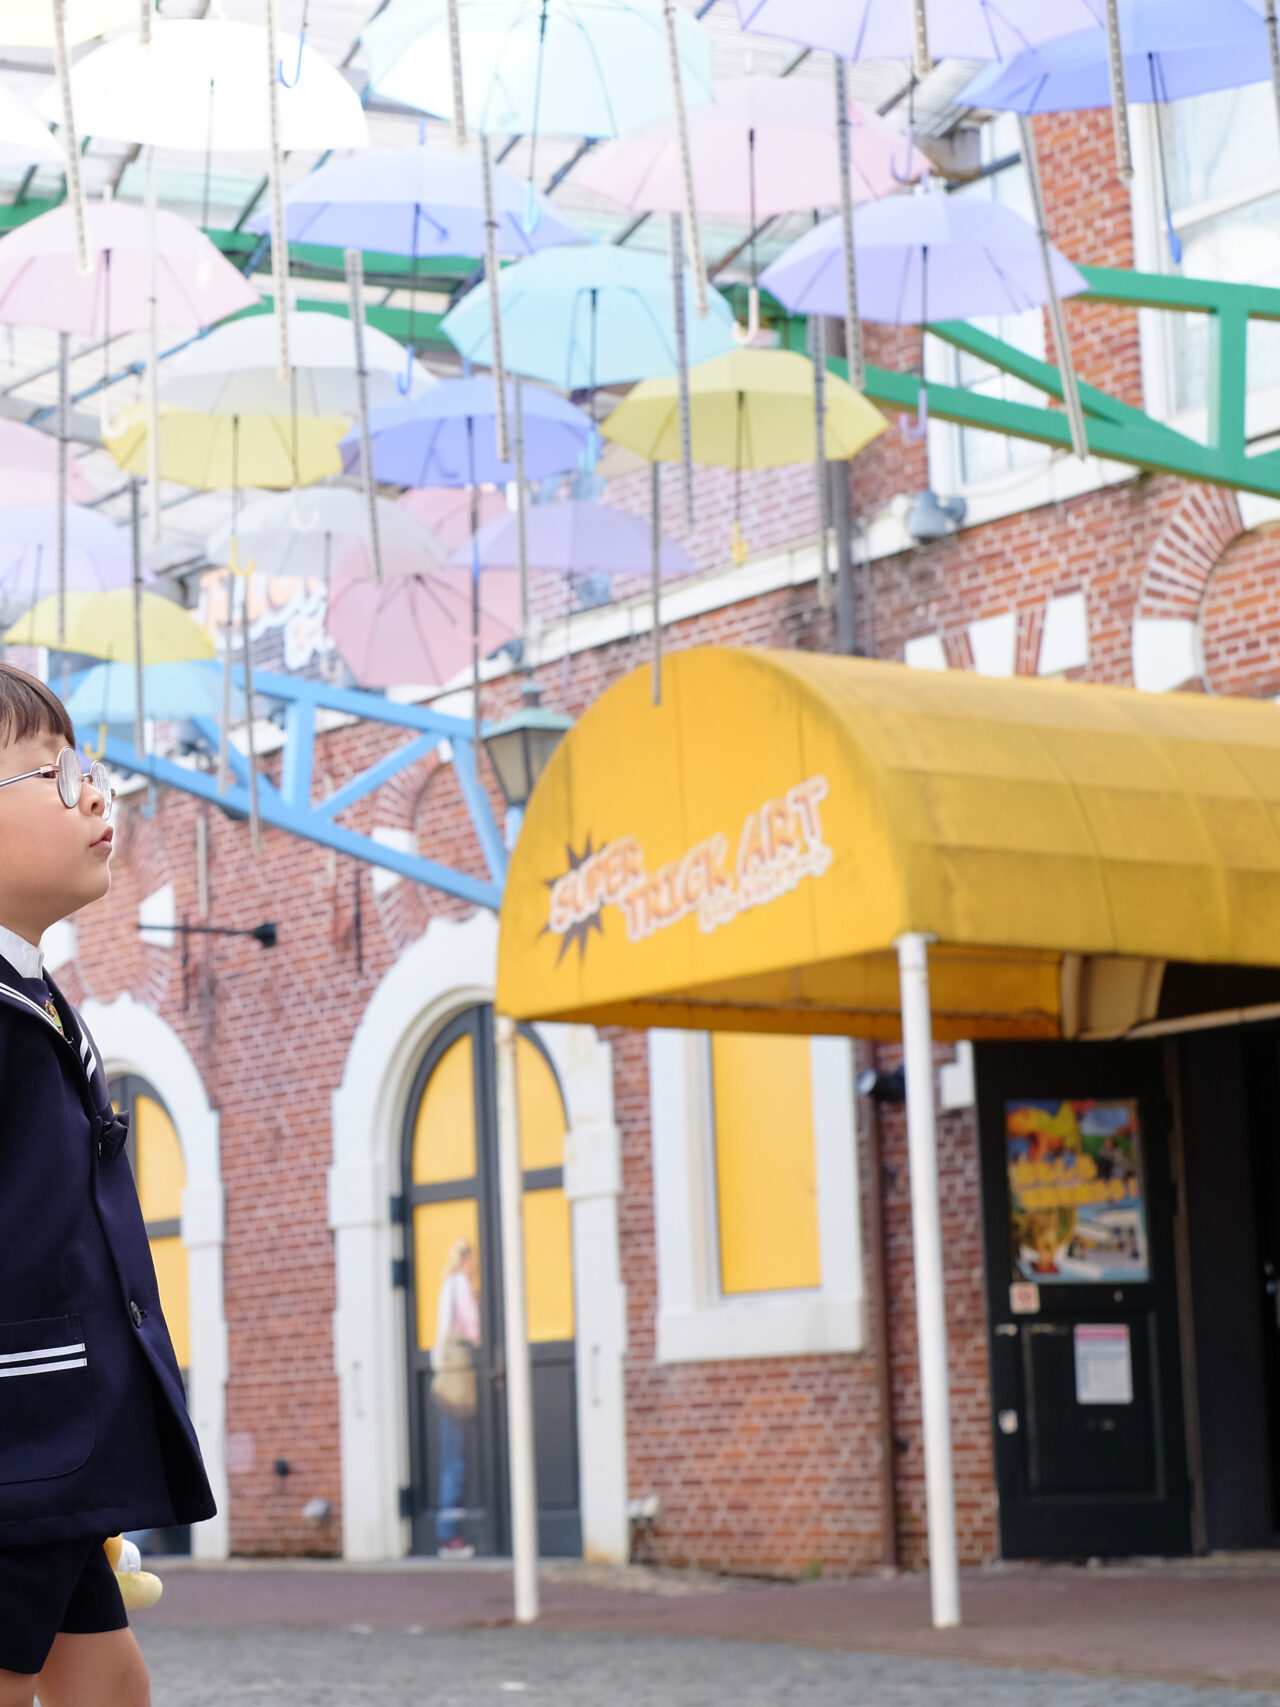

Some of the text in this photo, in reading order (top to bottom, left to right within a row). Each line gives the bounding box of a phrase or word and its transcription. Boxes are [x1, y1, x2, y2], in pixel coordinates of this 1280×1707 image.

[551, 836, 643, 932] SUPER
[622, 834, 732, 941] TRICK
[738, 775, 827, 880] ART
